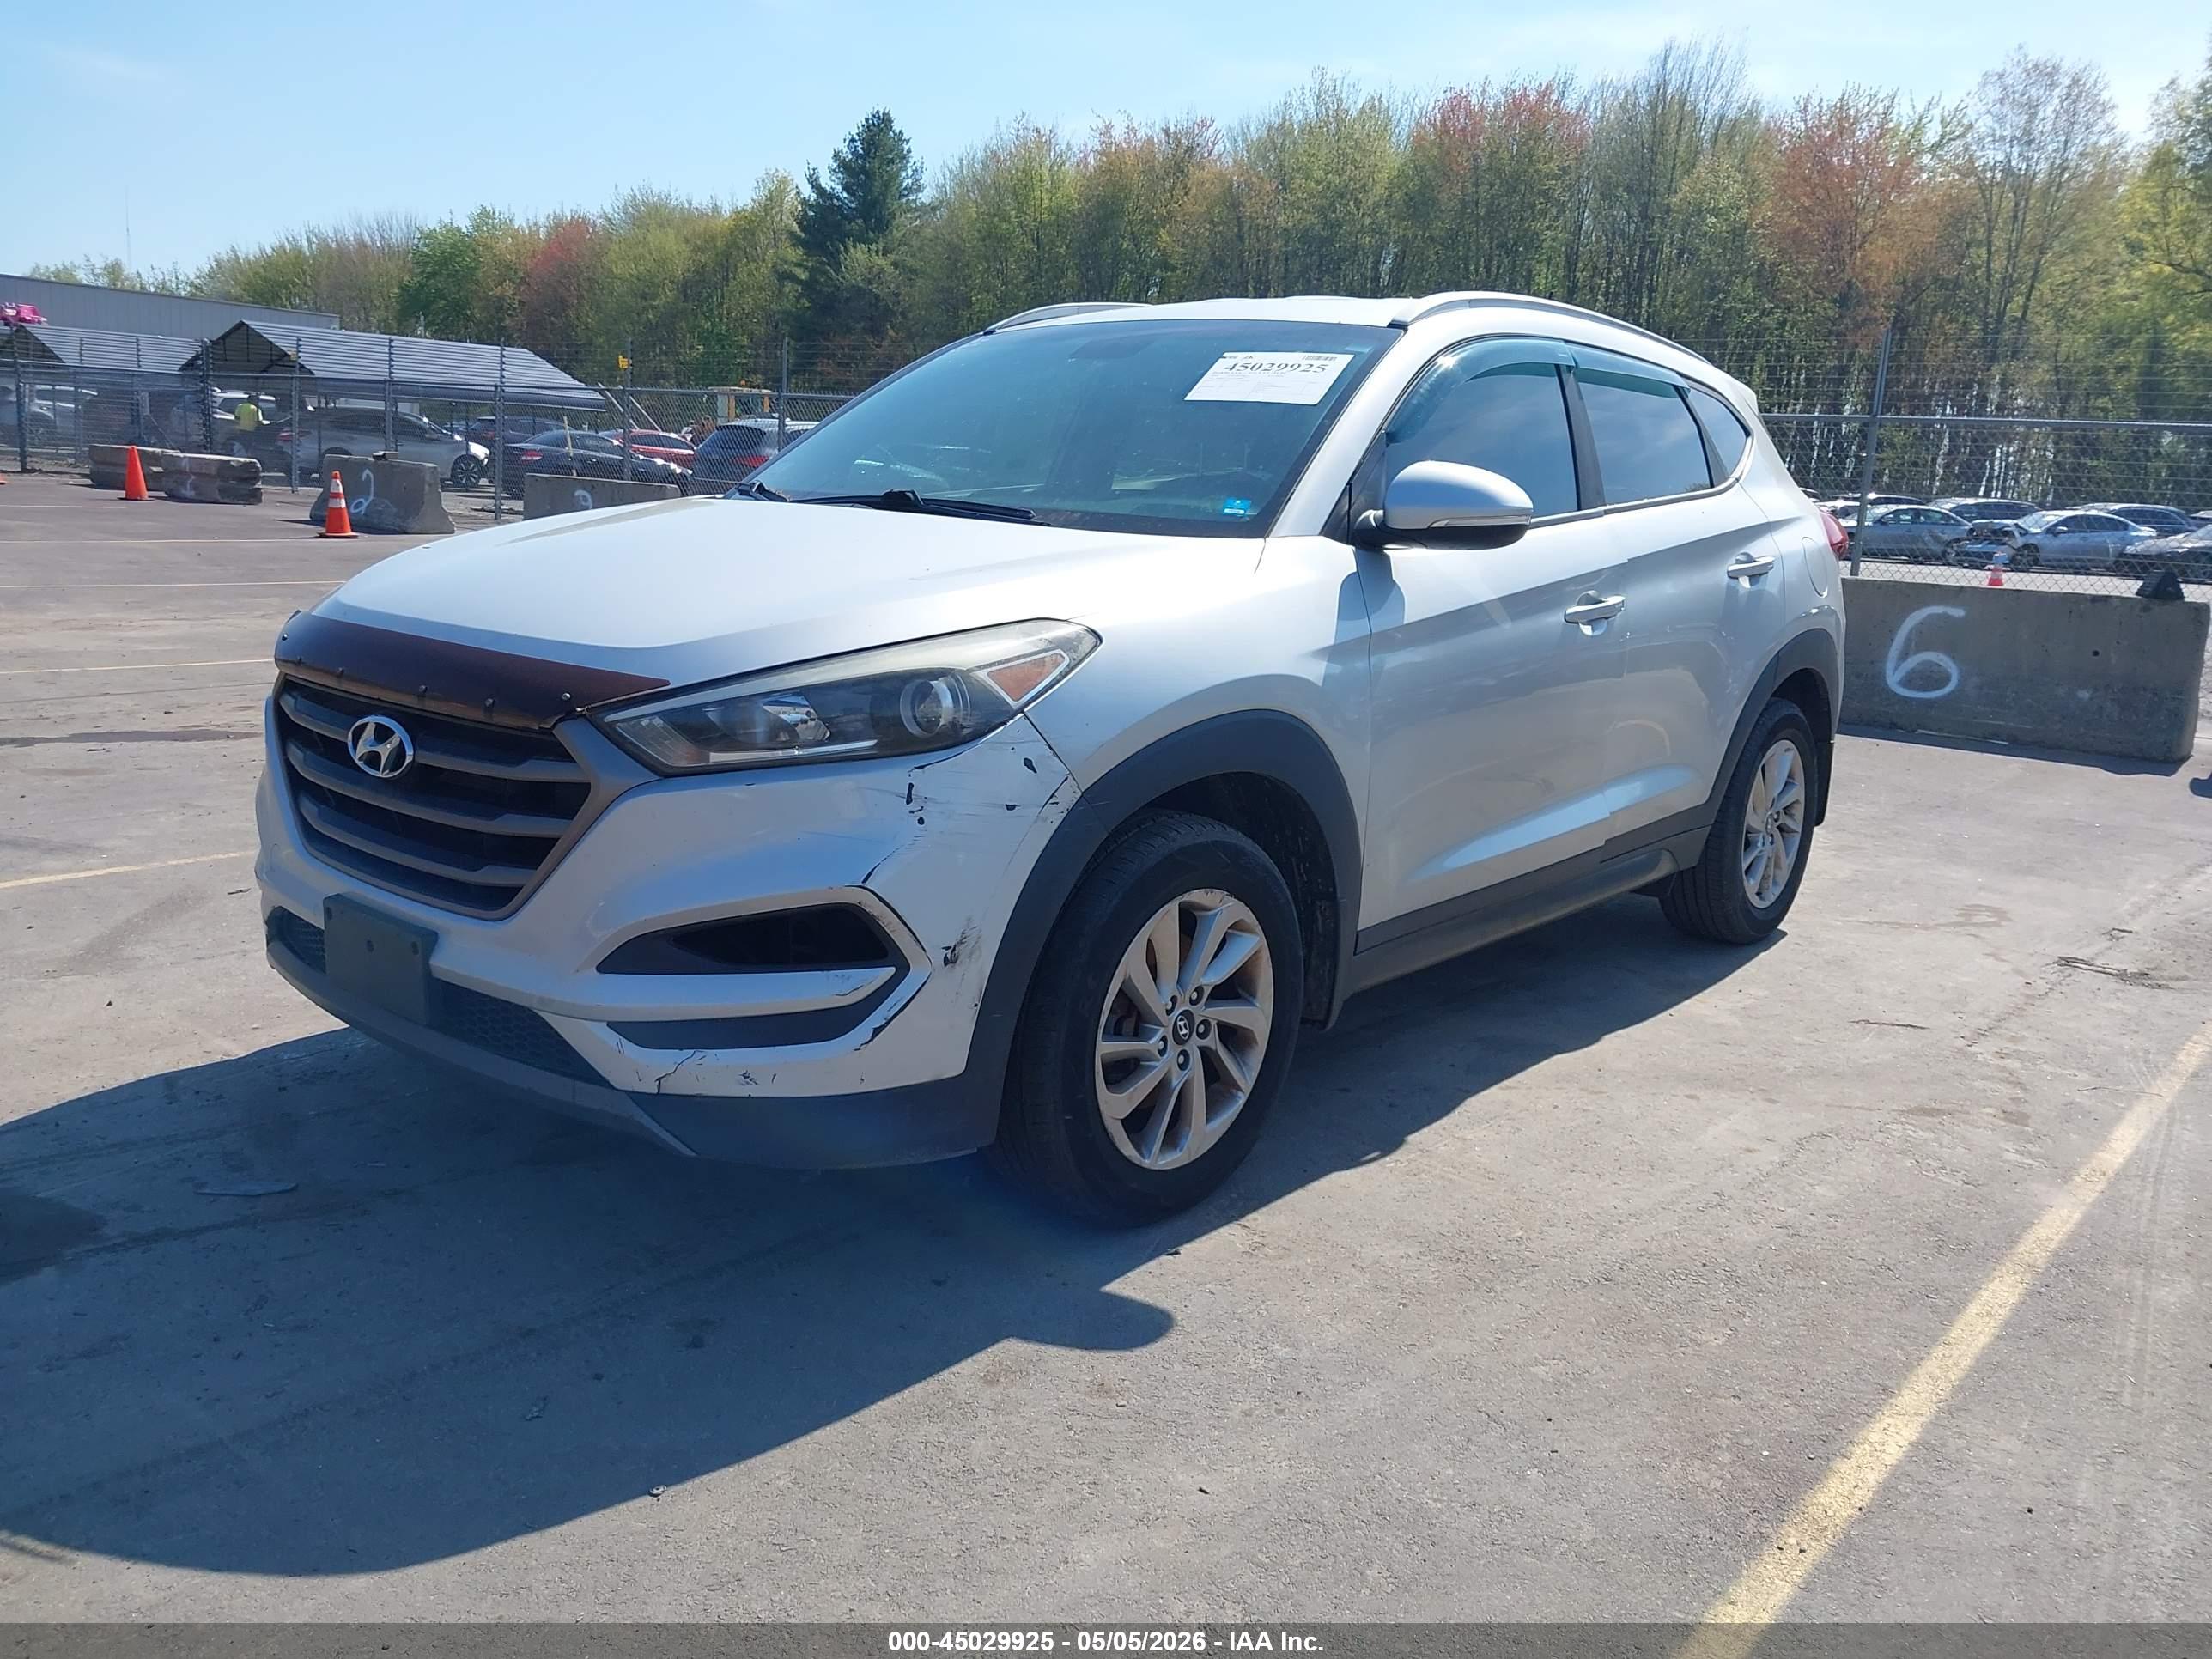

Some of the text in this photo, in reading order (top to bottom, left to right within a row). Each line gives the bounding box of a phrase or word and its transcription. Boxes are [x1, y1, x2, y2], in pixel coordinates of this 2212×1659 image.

[1224, 362, 1330, 374] 45029925
[349, 469, 374, 515] 2
[1886, 605, 1966, 698] 6
